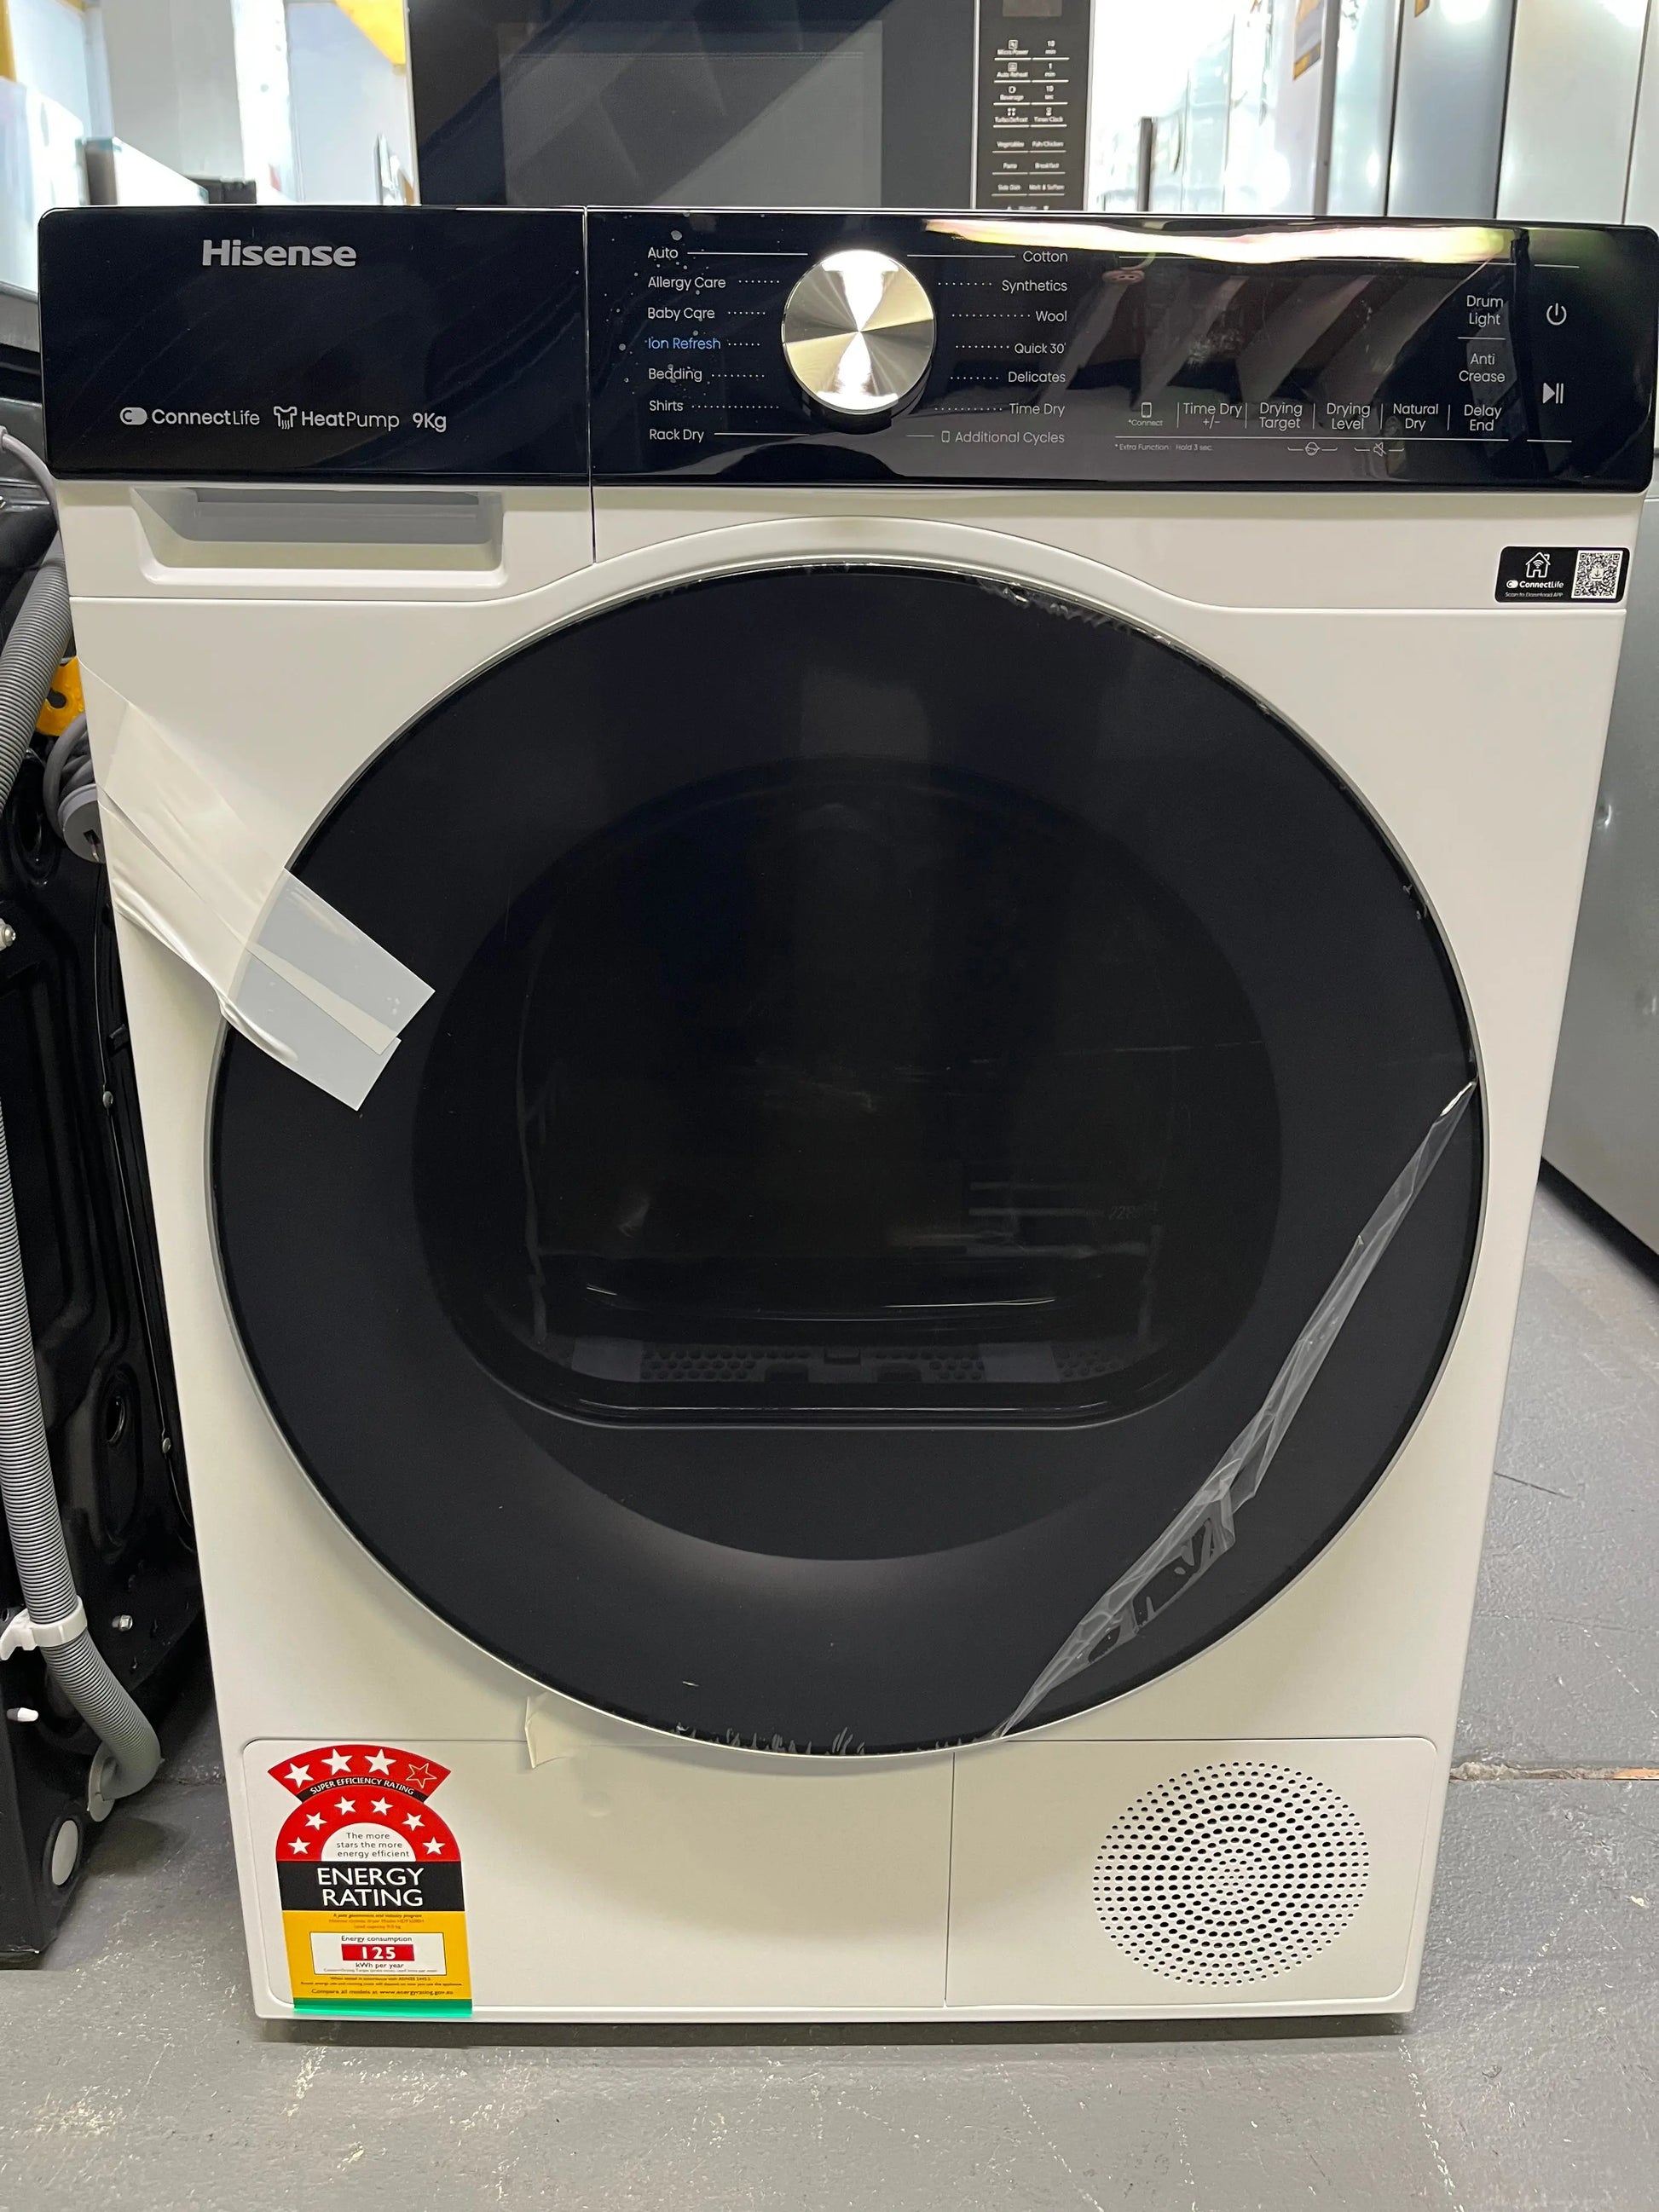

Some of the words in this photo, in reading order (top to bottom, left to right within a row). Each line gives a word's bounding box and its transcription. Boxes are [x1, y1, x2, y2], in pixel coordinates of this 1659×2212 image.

[202, 240, 357, 267] Hisense
[647, 246, 679, 259] Auto
[1023, 250, 1068, 263] Cotton
[648, 276, 692, 292] Allergy
[695, 276, 726, 289] Care
[1002, 280, 1068, 293] Synthetics
[1465, 294, 1504, 309] Drum
[648, 307, 679, 321] Baby
[683, 307, 715, 320] Care
[1035, 310, 1067, 322] Wool
[1468, 312, 1501, 327] Light
[648, 337, 669, 350] Ion
[673, 337, 721, 350] Refresh
[1014, 343, 1047, 355] Quick
[1470, 352, 1496, 366] Anti
[648, 367, 702, 383] Bedding
[1008, 371, 1066, 384] Delicates
[1459, 369, 1506, 384] Crease
[649, 399, 684, 413] Shirts
[1009, 402, 1040, 415] Time
[1042, 402, 1066, 418] Dry
[1182, 402, 1216, 415] Time
[1219, 402, 1243, 419] Dry
[1259, 401, 1303, 417] Drying
[1326, 402, 1371, 419] Drying
[1393, 401, 1439, 416] Natural
[1464, 403, 1502, 420] Delay
[151, 408, 260, 426] ConnectLife
[301, 411, 400, 432] HeatPump
[412, 412, 448, 433] 9Kg
[1259, 417, 1301, 431] Target
[1331, 416, 1365, 430] Level
[1404, 416, 1426, 432] Dry
[1469, 419, 1494, 432] End
[649, 428, 679, 441] Rack
[682, 428, 705, 444] Dry
[955, 431, 1020, 444] Additional
[1023, 431, 1065, 447] Cycles
[310, 1782, 336, 1794] SUPER
[336, 1777, 382, 1786] EFFICIENCY
[384, 1780, 414, 1795] RATING
[317, 1867, 425, 1886] ENERGY
[322, 1888, 425, 1907] RATING
[361, 1946, 396, 1960] 125
